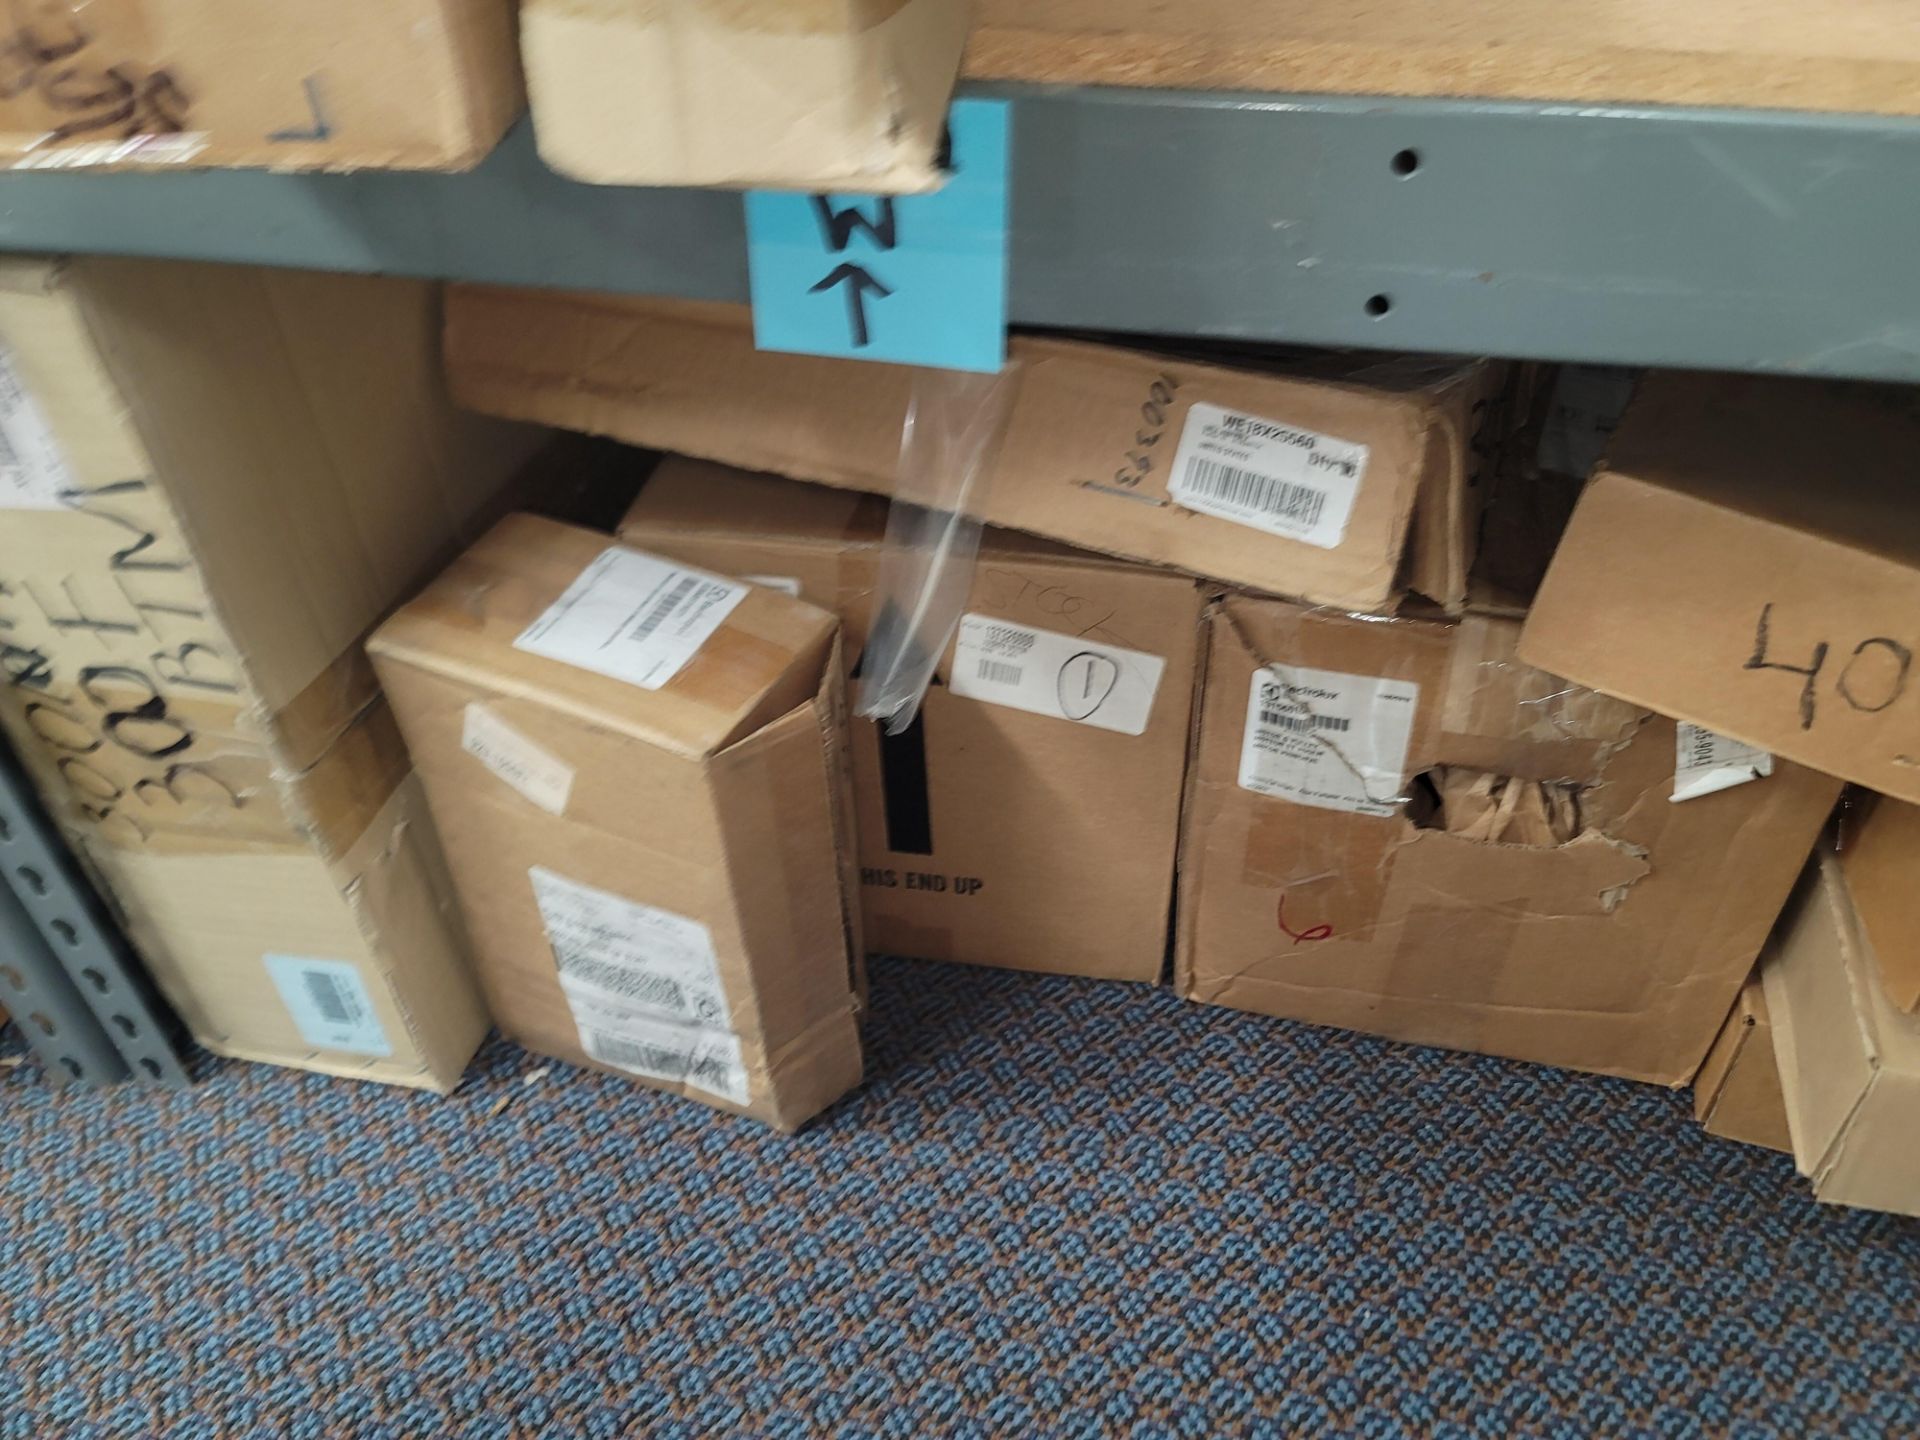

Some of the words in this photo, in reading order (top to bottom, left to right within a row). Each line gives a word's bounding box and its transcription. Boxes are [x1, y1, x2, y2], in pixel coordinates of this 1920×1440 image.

[1742, 601, 1912, 731] 40
[1279, 683, 1343, 701] lectrolux
[860, 867, 898, 888] HIS
[905, 872, 947, 892] END
[954, 877, 983, 896] UP
